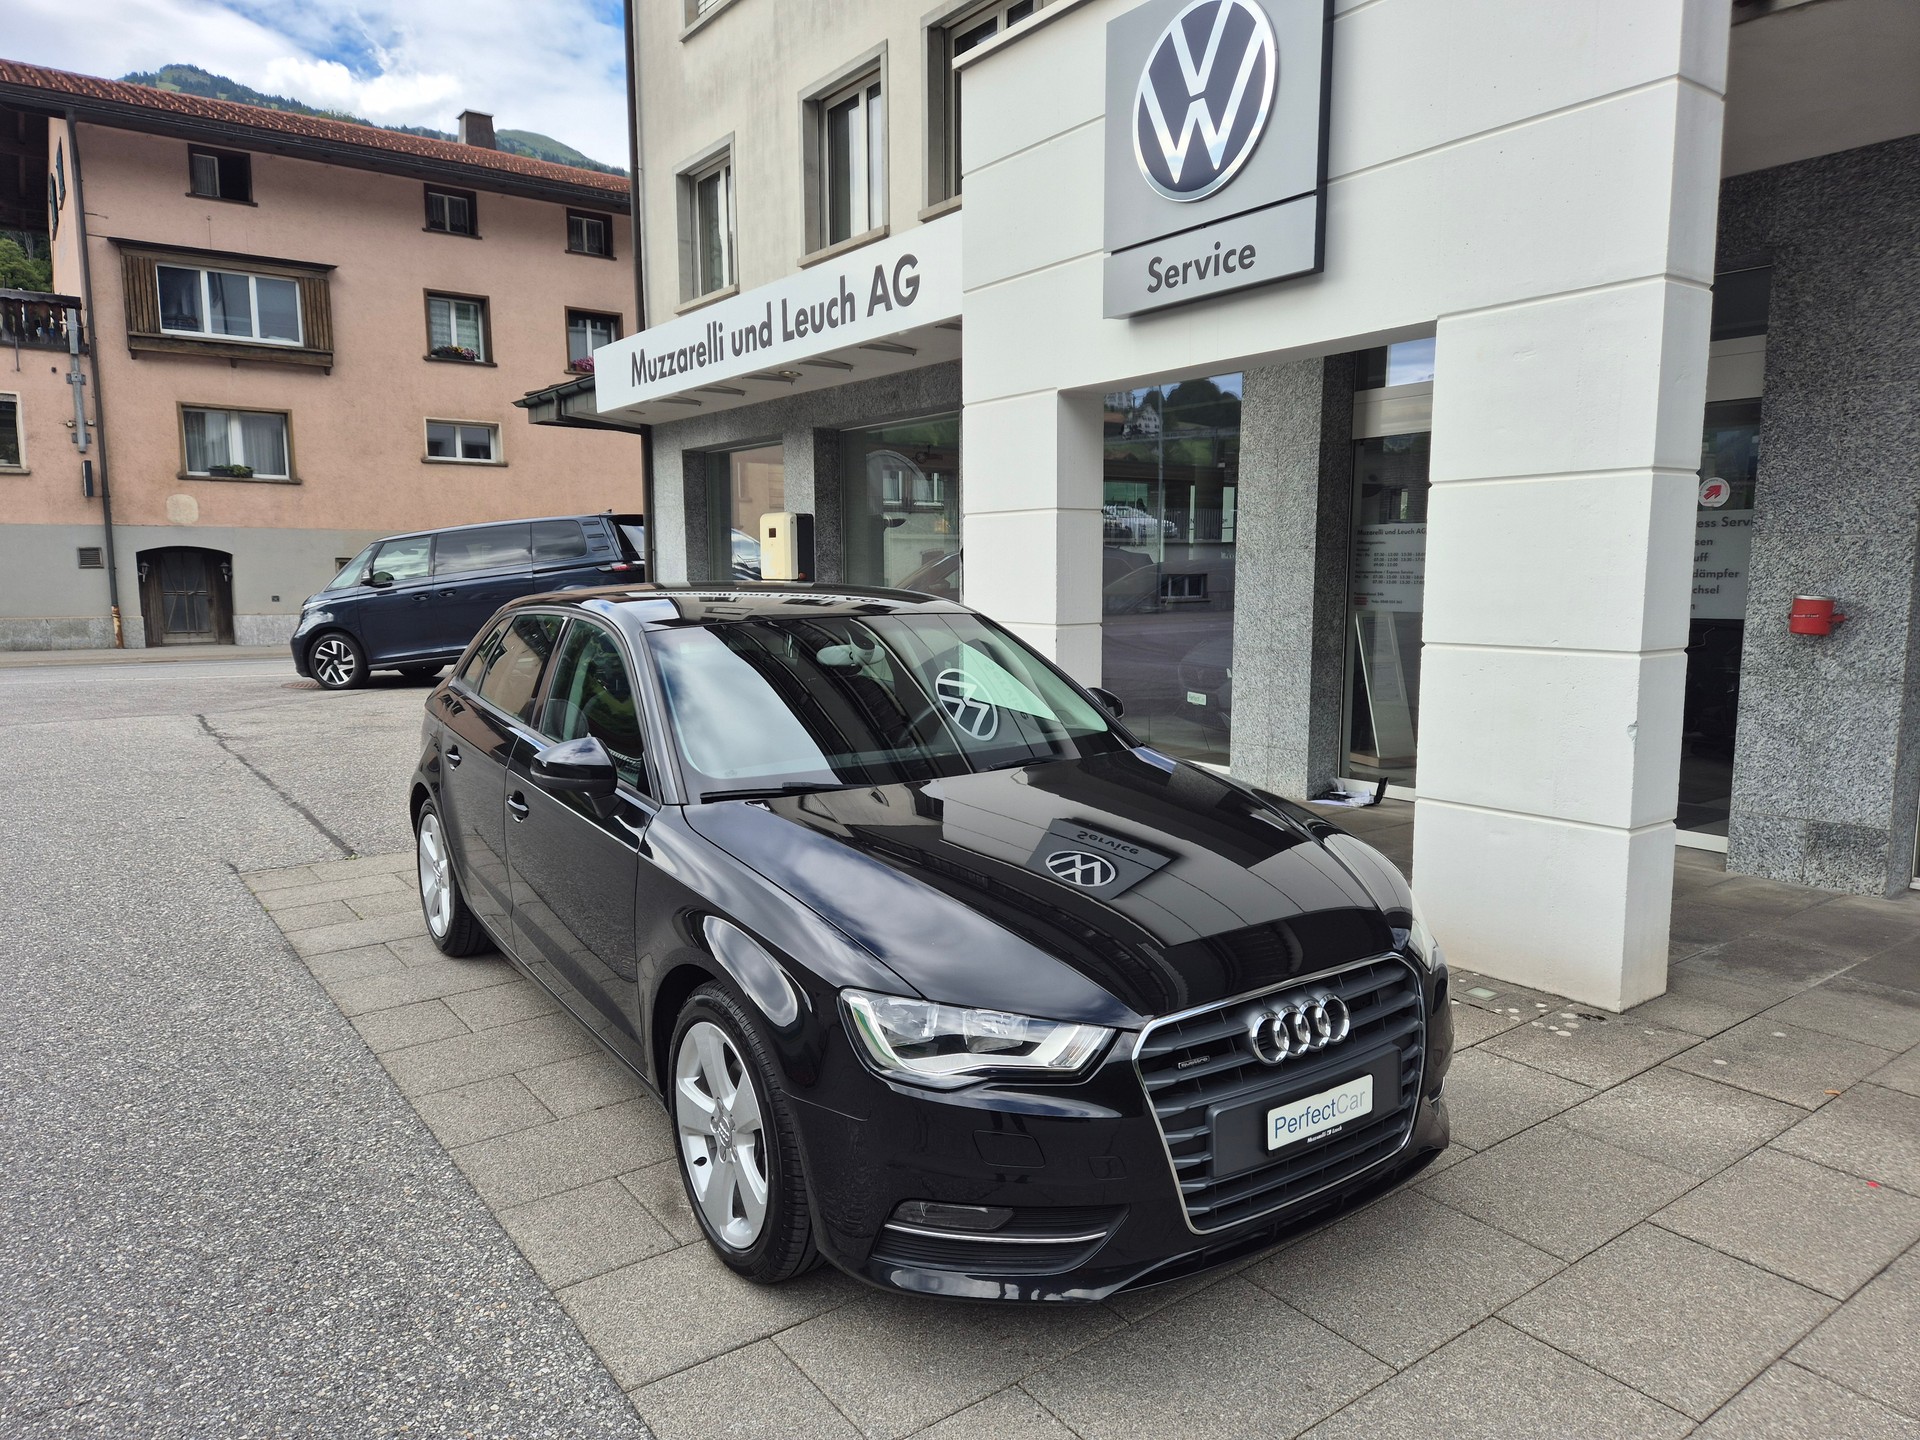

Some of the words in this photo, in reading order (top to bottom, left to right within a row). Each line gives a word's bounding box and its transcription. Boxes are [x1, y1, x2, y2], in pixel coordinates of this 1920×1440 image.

[1147, 241, 1256, 293] Service
[632, 321, 724, 387] Muzzarelli
[731, 301, 773, 357] und
[782, 275, 855, 342] Leuch
[867, 254, 920, 317] AG
[1693, 552, 1709, 562] uff
[1692, 568, 1740, 580] dämpfer
[1692, 584, 1720, 594] chsel
[1275, 1091, 1365, 1139] PerfectCar
